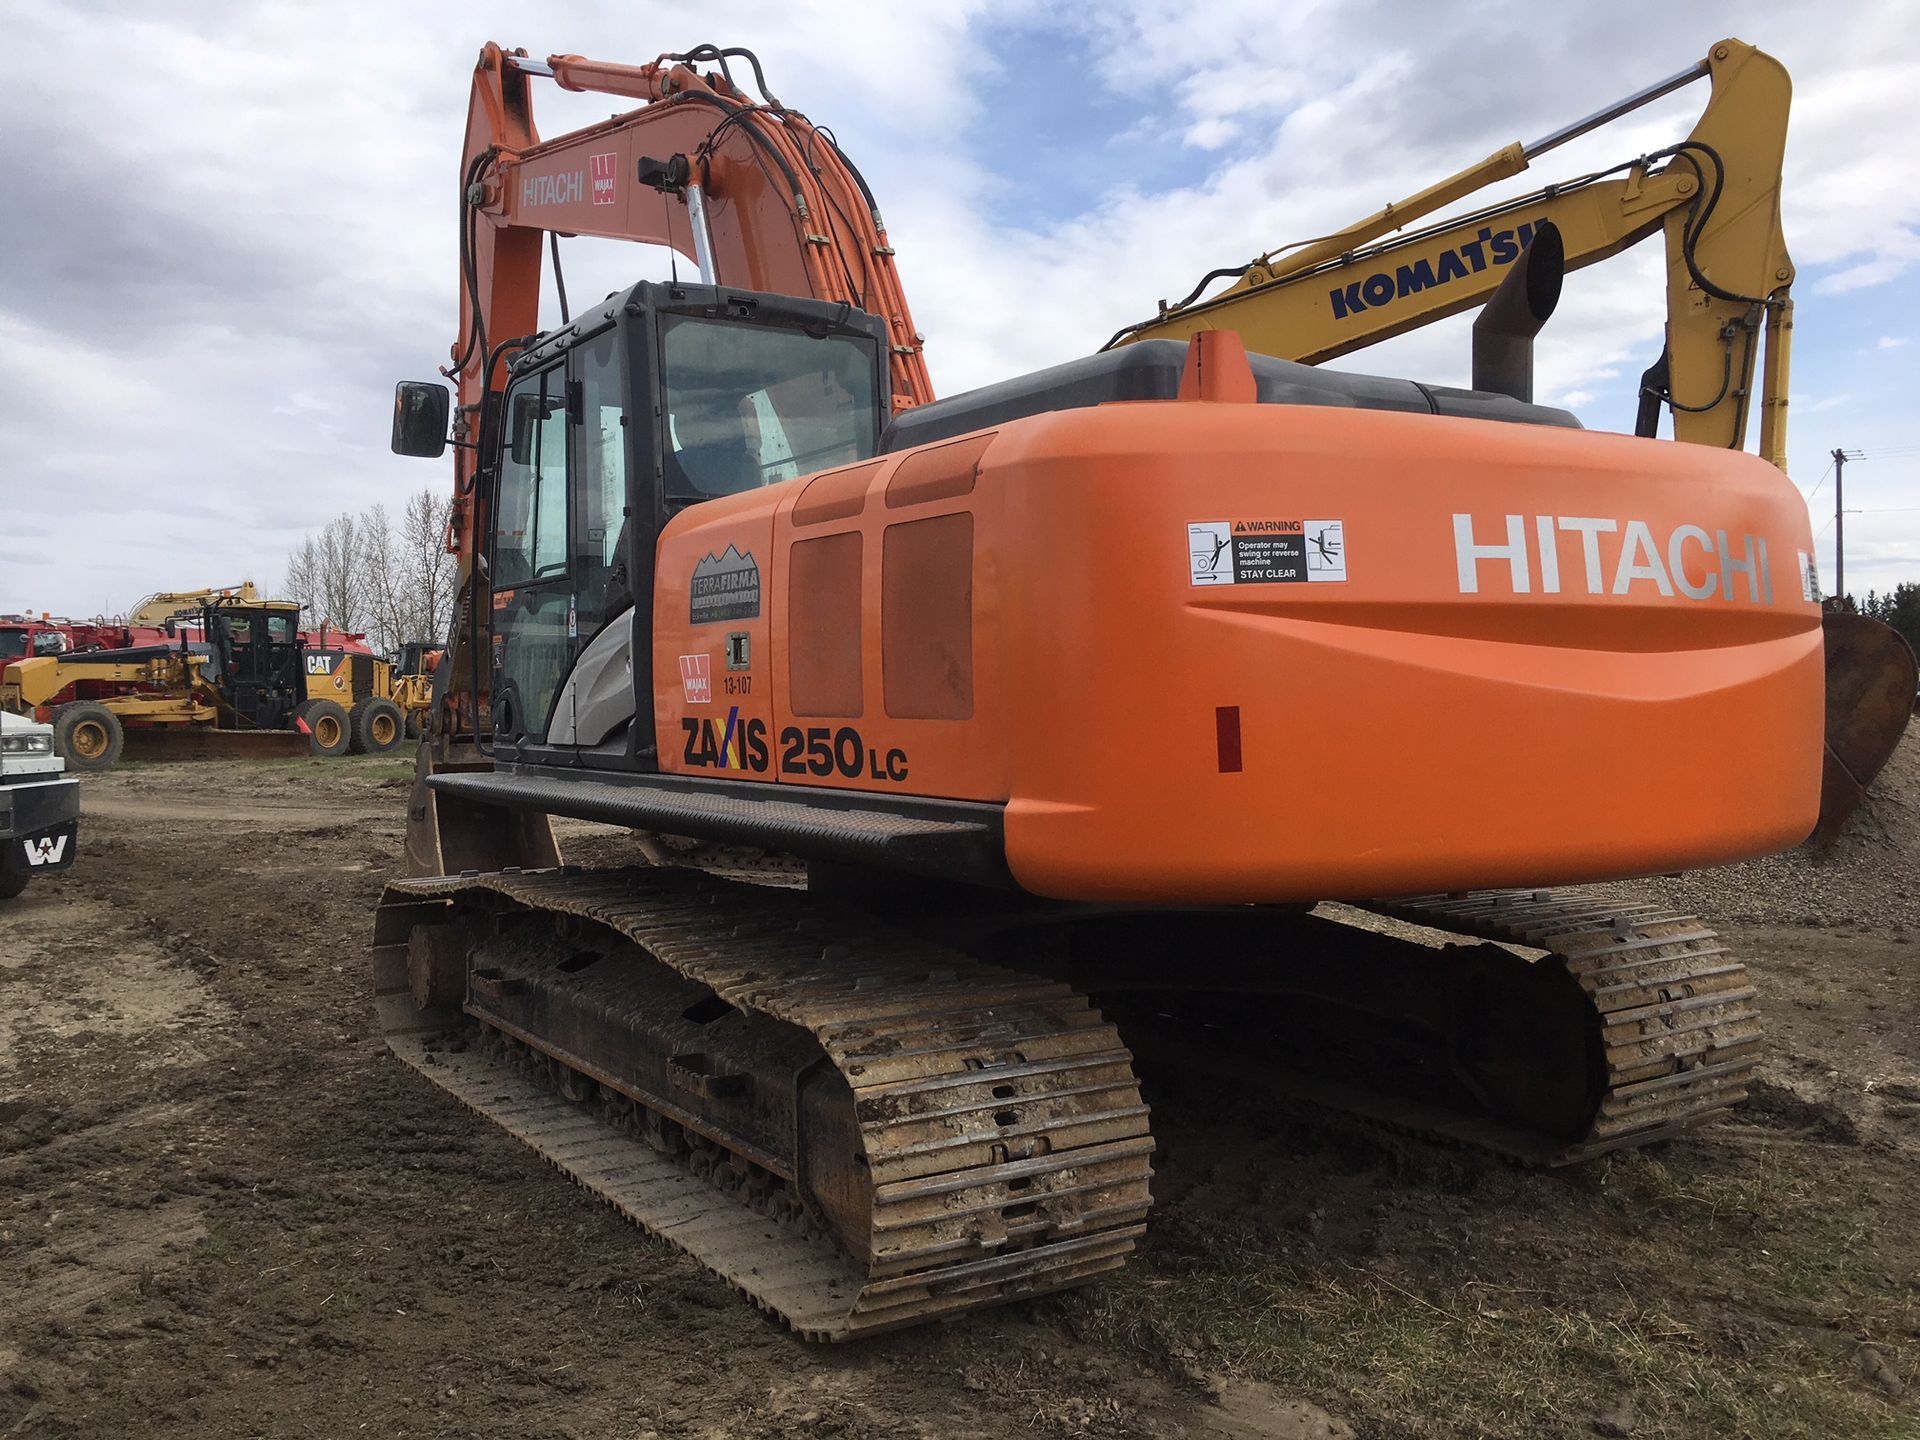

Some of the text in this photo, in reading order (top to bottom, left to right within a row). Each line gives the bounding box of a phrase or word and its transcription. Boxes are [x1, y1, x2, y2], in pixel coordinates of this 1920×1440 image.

[523, 171, 584, 207] HITACHI
[594, 180, 614, 194] WAJAX
[1247, 521, 1300, 532] WARNING
[1238, 541, 1288, 550] Operator may
[1238, 550, 1261, 559] swing
[1452, 513, 1774, 605] HITACHI
[1239, 558, 1271, 566] machine
[1240, 569, 1296, 579] STAY CLEAR
[306, 655, 331, 675] CAT
[686, 678, 707, 693] WAJAX
[723, 676, 752, 695] 13-107
[682, 706, 909, 782] ZAXIS 250 LC
